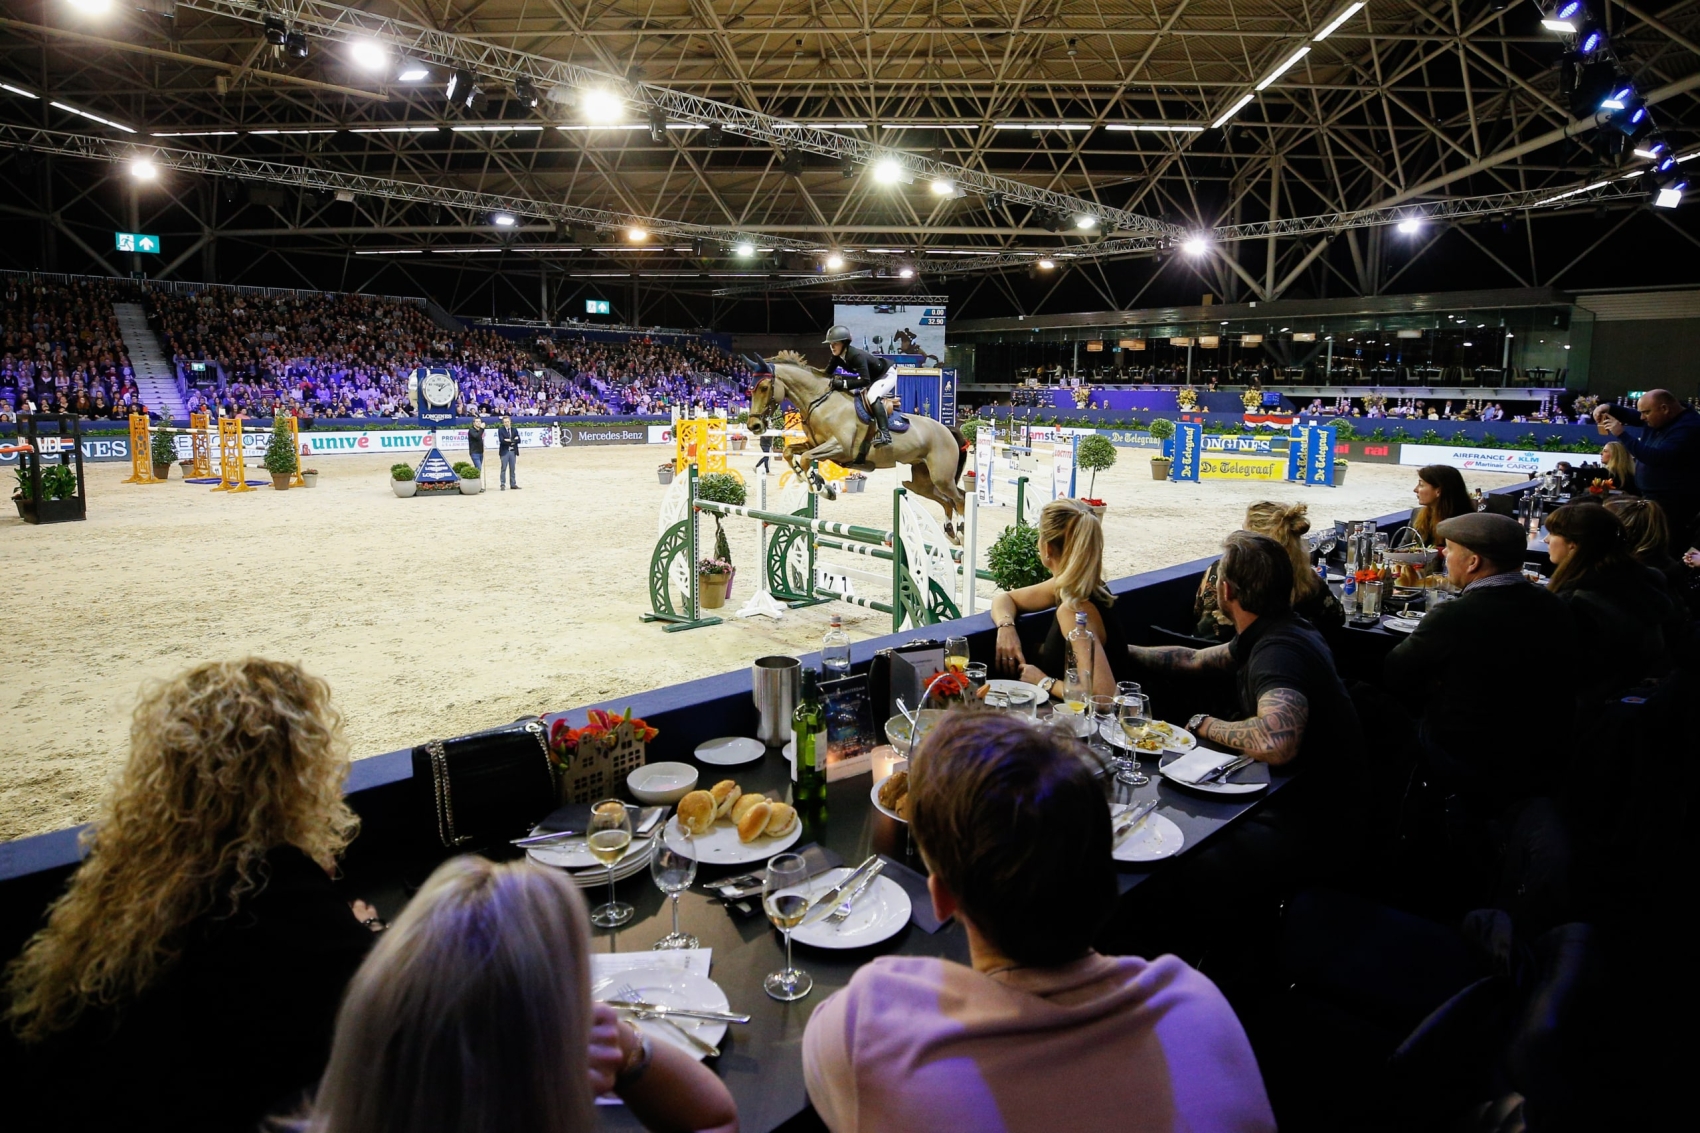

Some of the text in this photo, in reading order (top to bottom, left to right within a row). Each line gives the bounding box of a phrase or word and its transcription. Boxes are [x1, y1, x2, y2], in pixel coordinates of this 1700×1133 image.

[311, 432, 369, 450] univé
[380, 431, 433, 447] univé
[578, 430, 643, 441] Mercedes-Benz
[36, 437, 66, 453] VDL
[1200, 438, 1271, 453] ONGINES
[1333, 443, 1350, 454] ai
[1364, 445, 1389, 456] rai
[1054, 449, 1073, 459] LOCTITE
[1200, 461, 1275, 478] De Telegraaf
